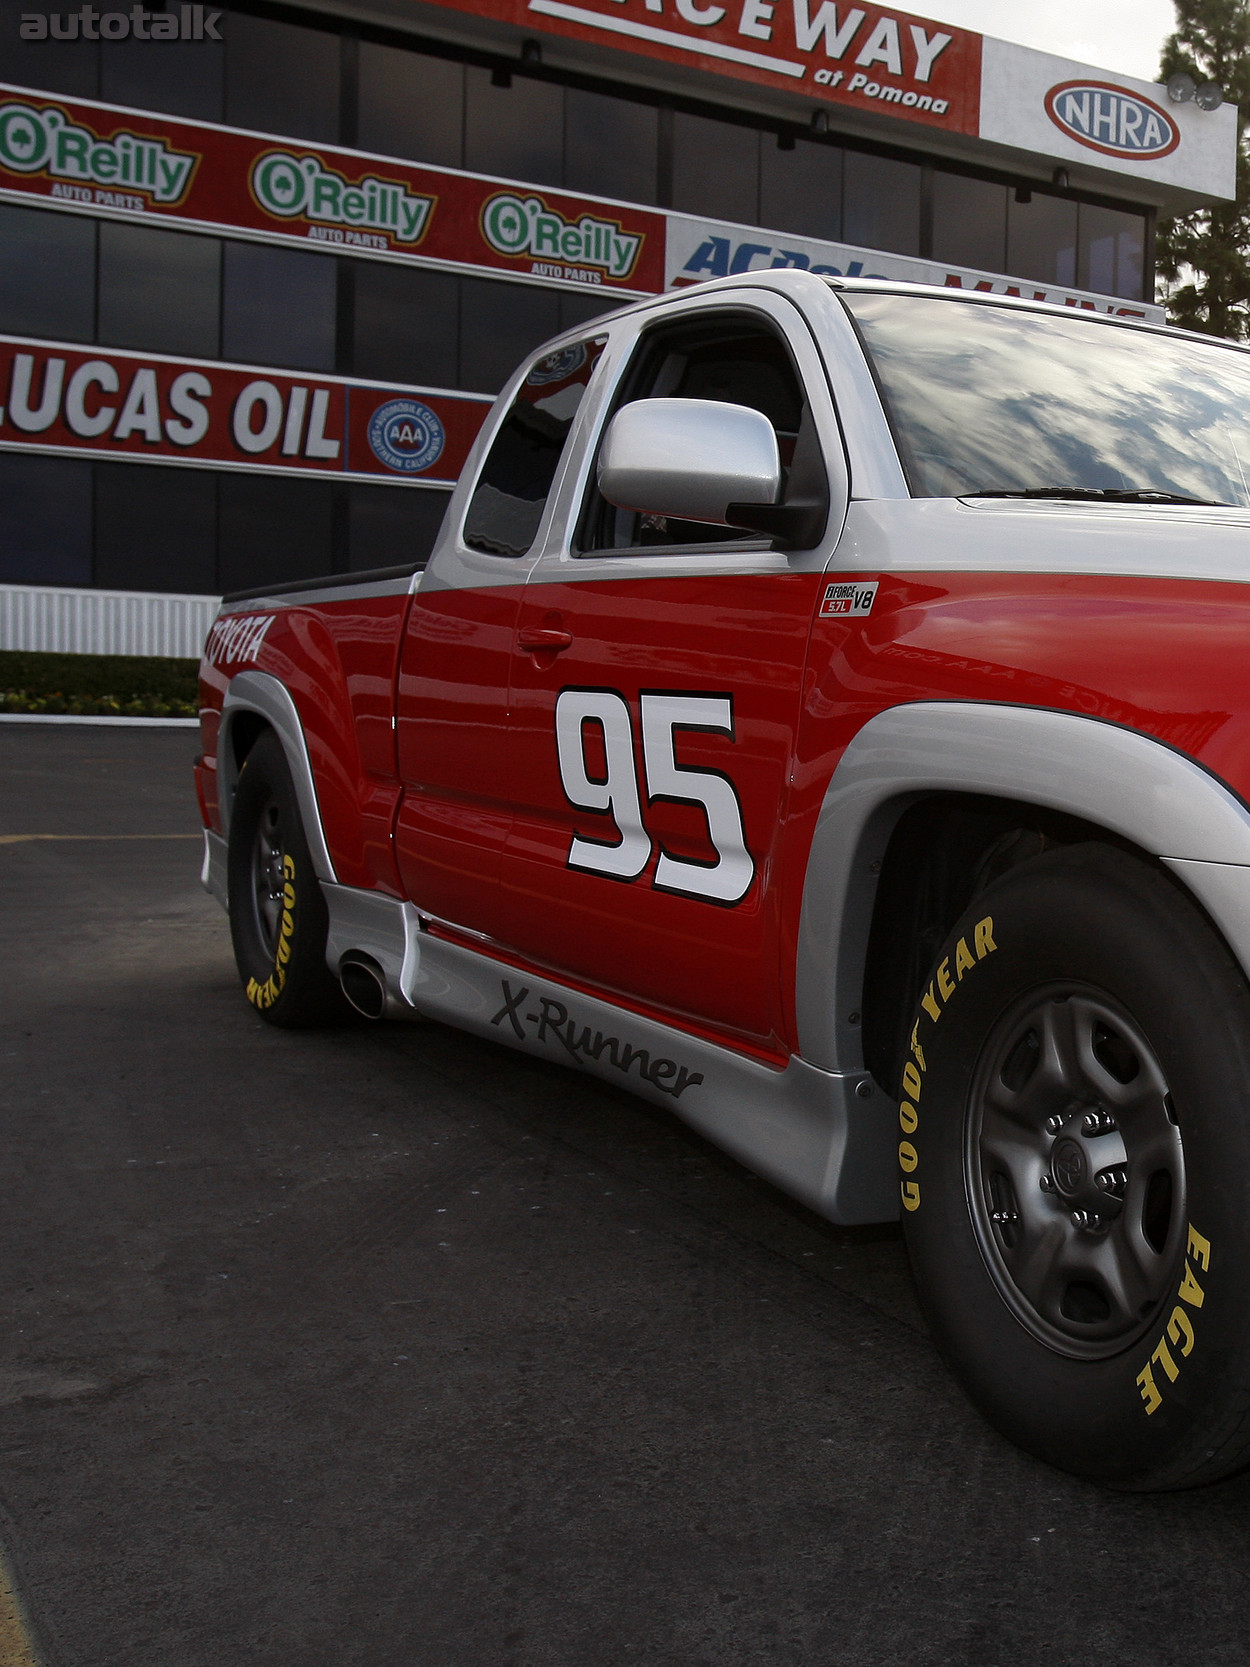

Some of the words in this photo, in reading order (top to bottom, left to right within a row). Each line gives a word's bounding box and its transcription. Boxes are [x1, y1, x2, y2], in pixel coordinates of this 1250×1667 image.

[814, 67, 843, 86] at
[847, 74, 949, 114] Pomona
[1064, 92, 1163, 148] NHRA
[0, 110, 186, 196] O'Reilly
[51, 183, 92, 201] AUTO
[95, 190, 145, 211] PARTS
[260, 159, 423, 236] O'Reilly
[308, 226, 344, 242] AUTO
[346, 232, 389, 250] PARTS
[489, 201, 633, 271] O'Reilly
[531, 262, 561, 277] AUTO
[564, 267, 602, 284] PARTS
[0, 353, 213, 447] UCAS
[232, 379, 341, 459] OIL
[389, 424, 424, 444] AAA
[828, 601, 846, 612] 5.7L
[853, 590, 874, 609] V8
[205, 614, 276, 666] TOYOTA
[555, 685, 757, 909] 95
[490, 979, 705, 1099] X-Runner
[1136, 1222, 1211, 1416] EAGLE
